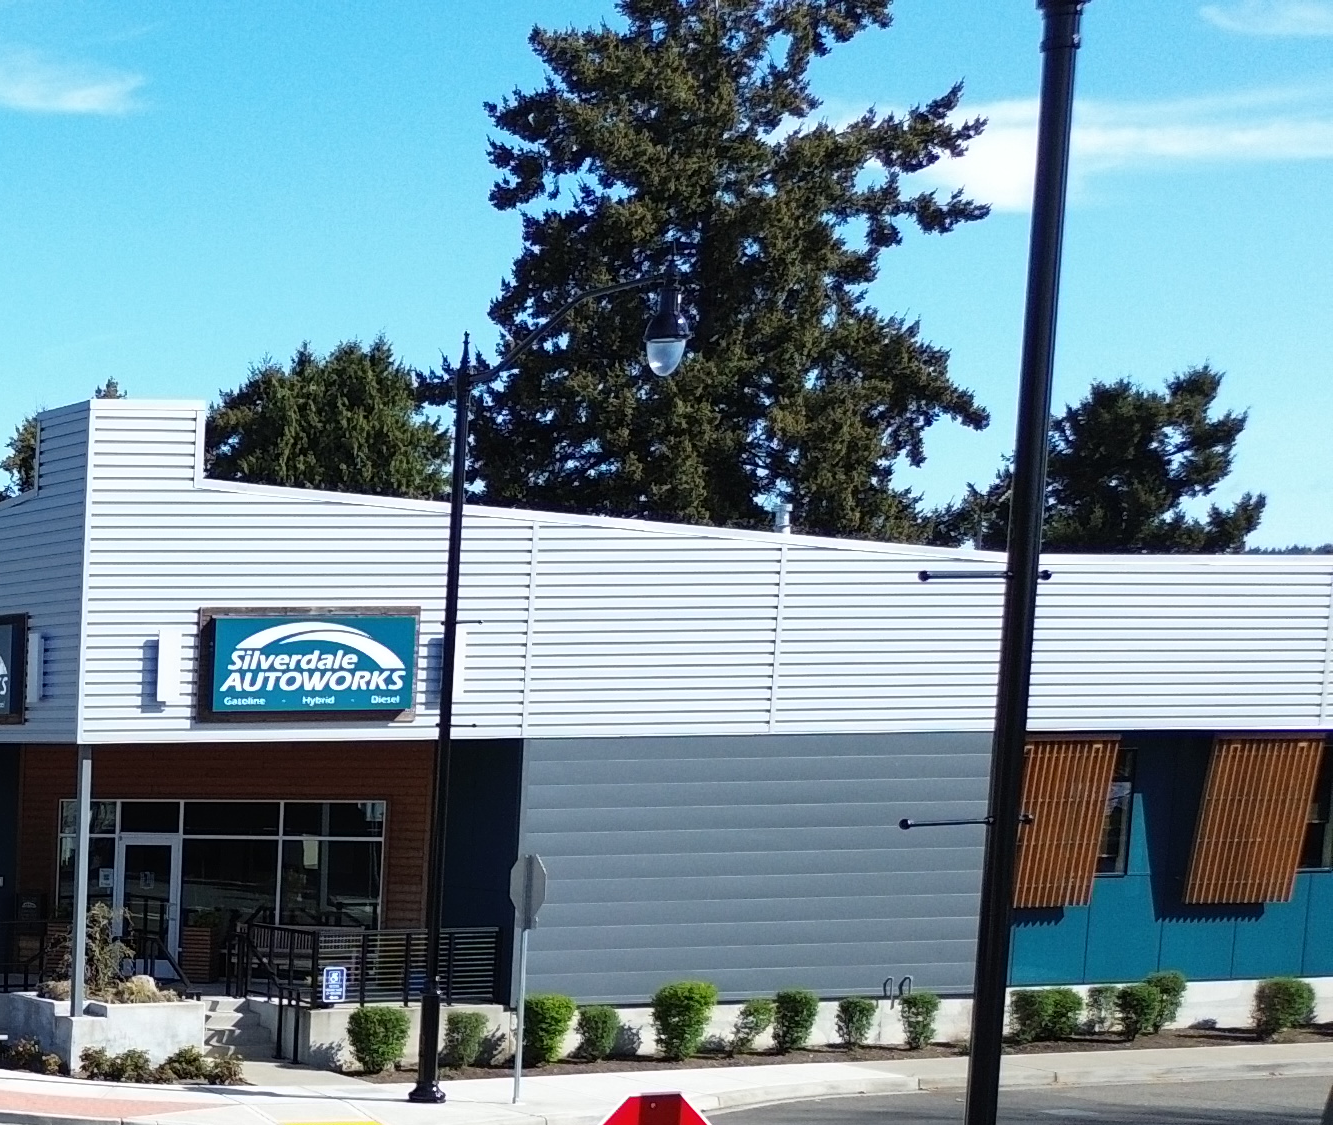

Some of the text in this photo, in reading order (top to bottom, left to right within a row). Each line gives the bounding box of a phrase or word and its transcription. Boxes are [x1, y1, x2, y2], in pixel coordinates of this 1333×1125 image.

[228, 650, 358, 670] Silverdale
[220, 670, 406, 691] AUTOWORKS
[224, 695, 400, 706] Gasoline Hybrid Diesel
